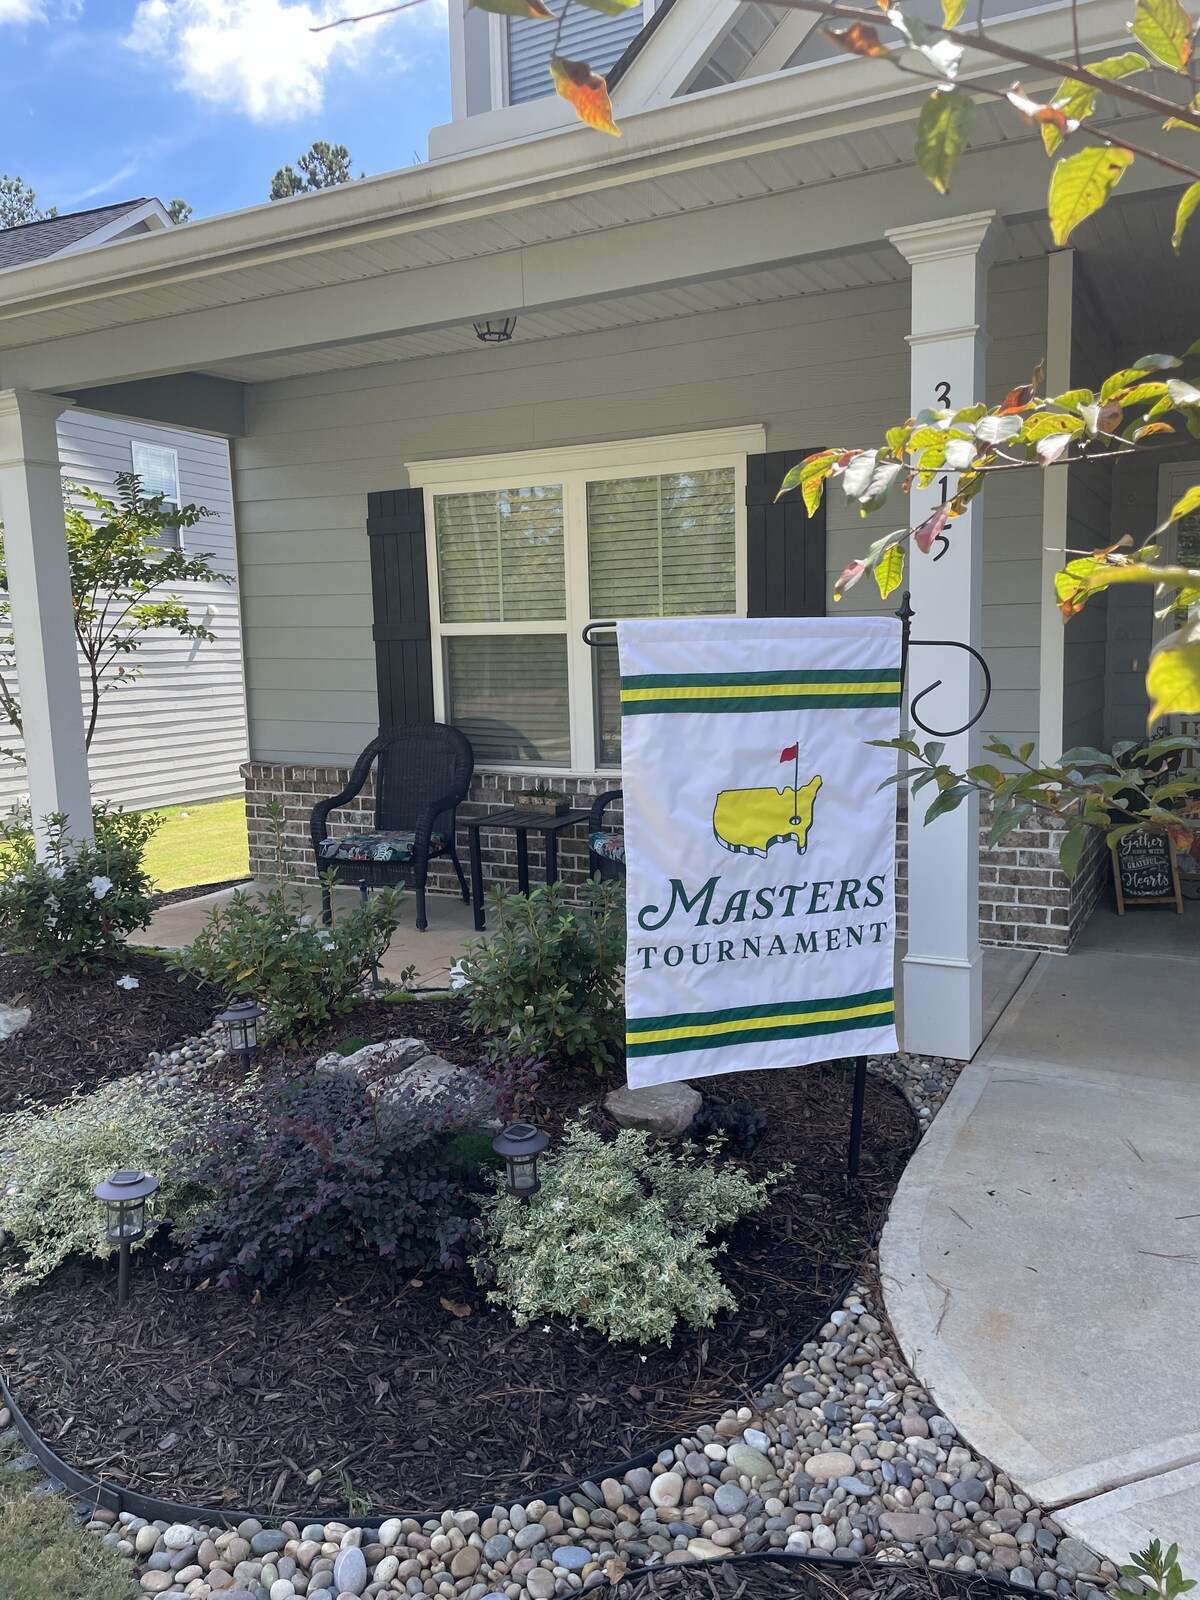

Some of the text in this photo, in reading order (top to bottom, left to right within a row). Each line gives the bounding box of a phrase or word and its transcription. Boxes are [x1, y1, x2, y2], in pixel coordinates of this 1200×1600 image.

[1121, 833, 1165, 855] Gather
[1127, 857, 1158, 869] GRATEFUL
[1121, 872, 1169, 888] Hearts
[637, 874, 887, 932] MASTERS
[637, 921, 888, 970] TOURNAMENT
